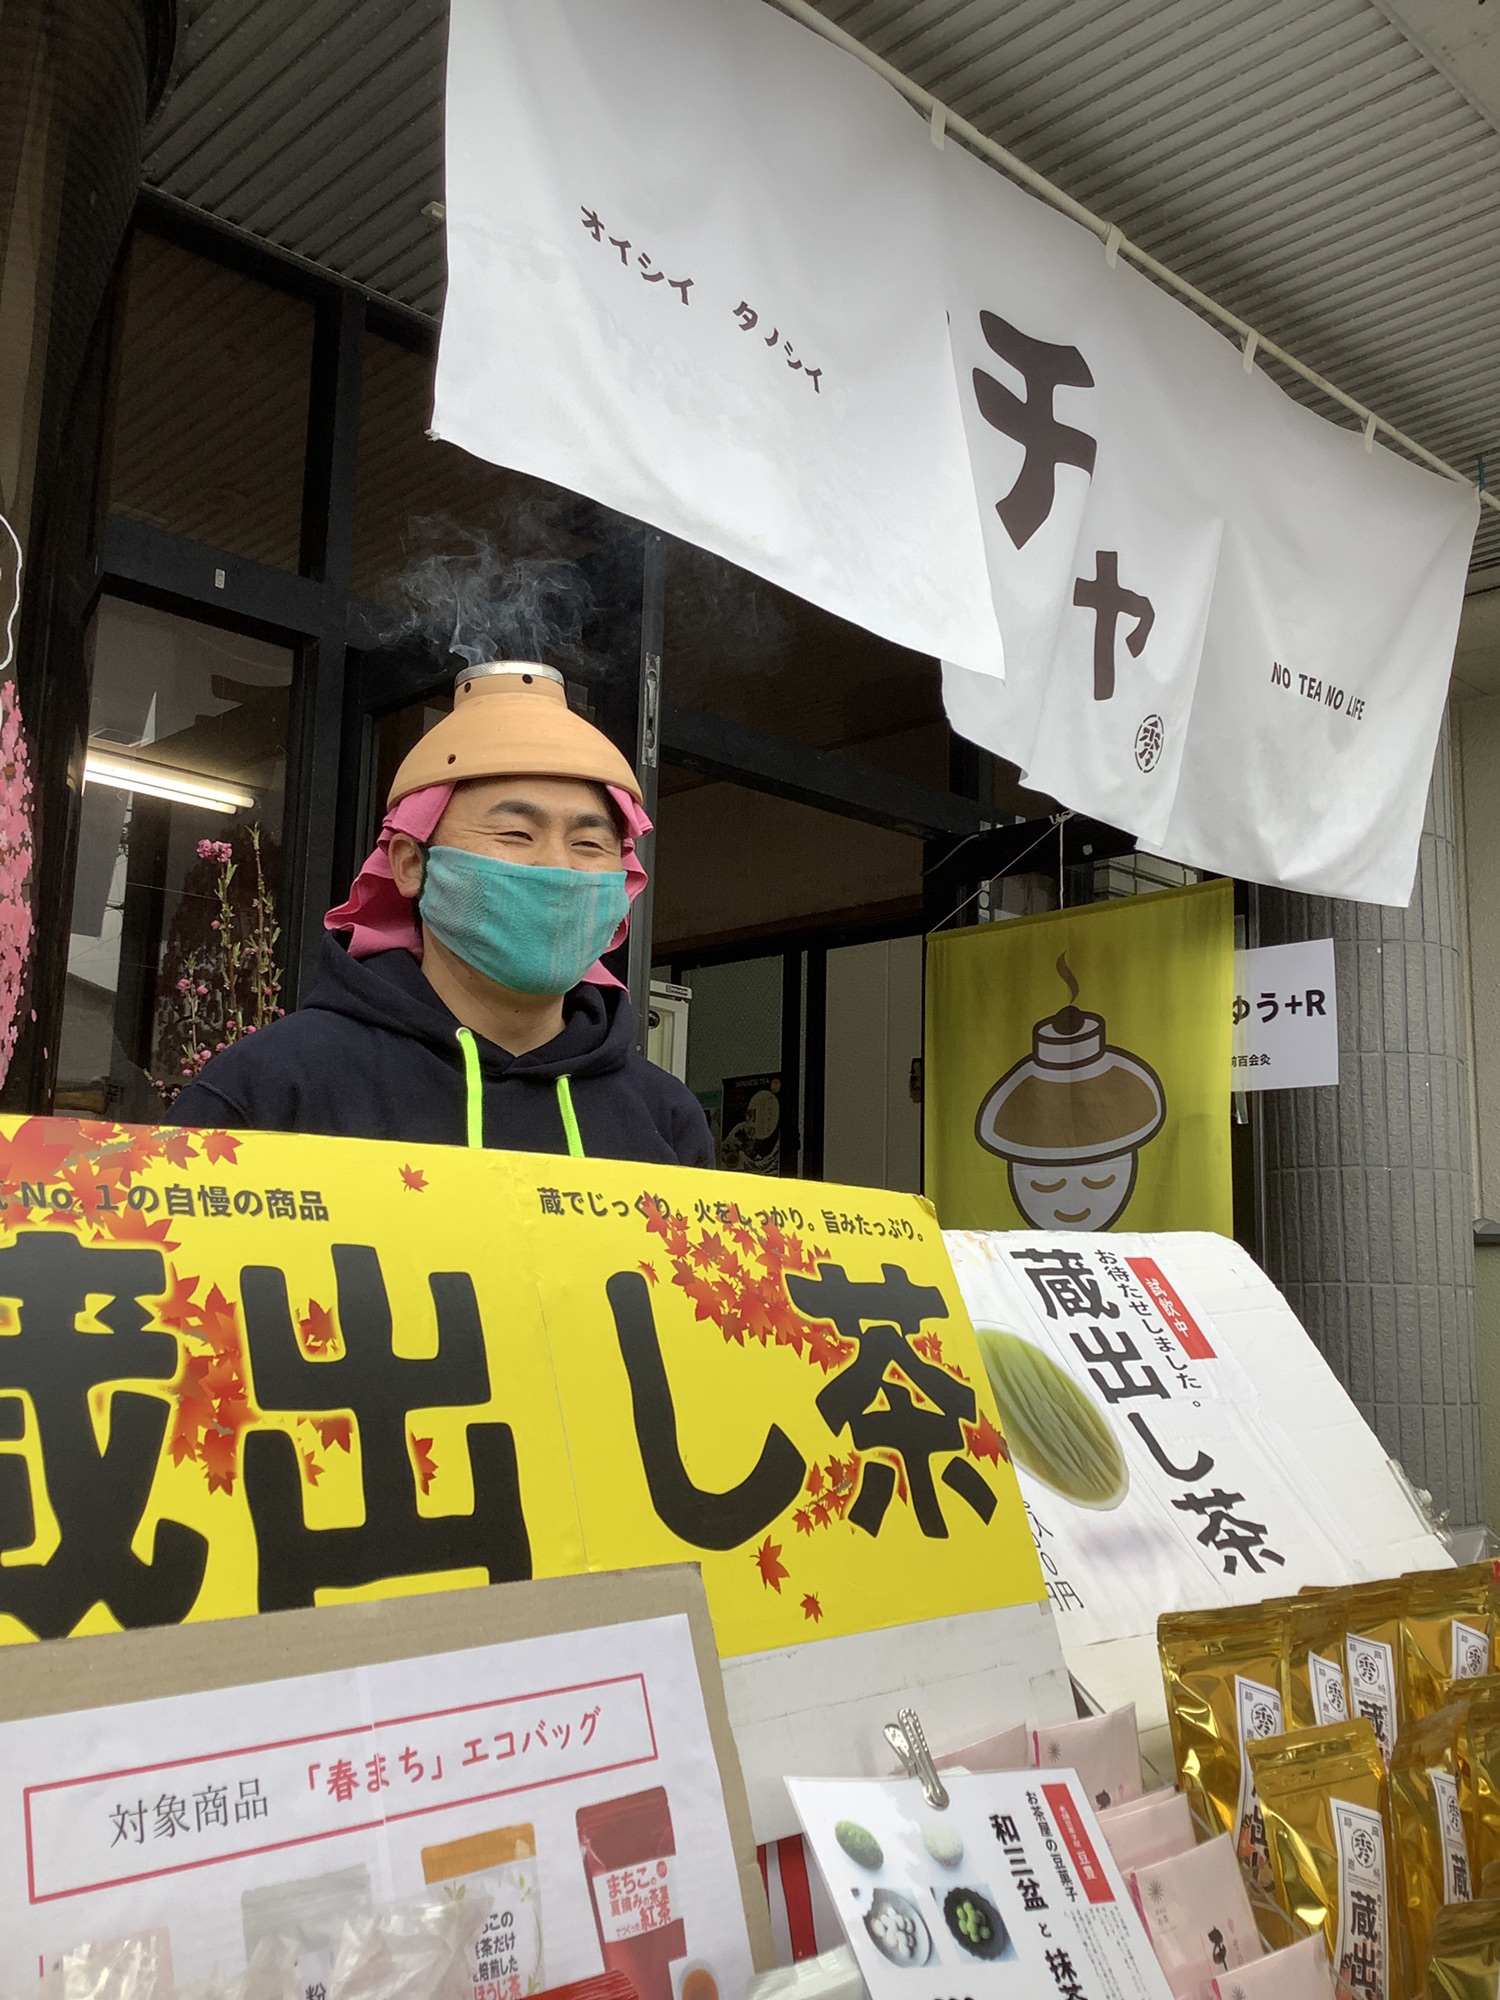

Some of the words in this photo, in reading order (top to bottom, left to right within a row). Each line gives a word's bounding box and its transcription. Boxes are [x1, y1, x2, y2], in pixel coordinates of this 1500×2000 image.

[580, 205, 695, 306] オイシイ
[732, 300, 823, 394] タノシイ
[972, 309, 1157, 702] チャ
[1270, 661, 1292, 689] NO
[1298, 673, 1323, 702] TEA
[1324, 684, 1345, 710] NO
[1345, 695, 1366, 721] LIFE
[1094, 1248, 1203, 1409] お待たせしました。
[1144, 1276, 1190, 1338] 試飲中
[1010, 1247, 1286, 1576] 蔵出し茶
[108, 1777, 270, 1848] 対象商品
[1025, 1789, 1079, 1903] お茶屋の豆菓子
[606, 1866, 657, 1899] まちこの
[475, 1931, 516, 1960] 茶だけ
[1350, 1890, 1378, 2000] 蔵出
